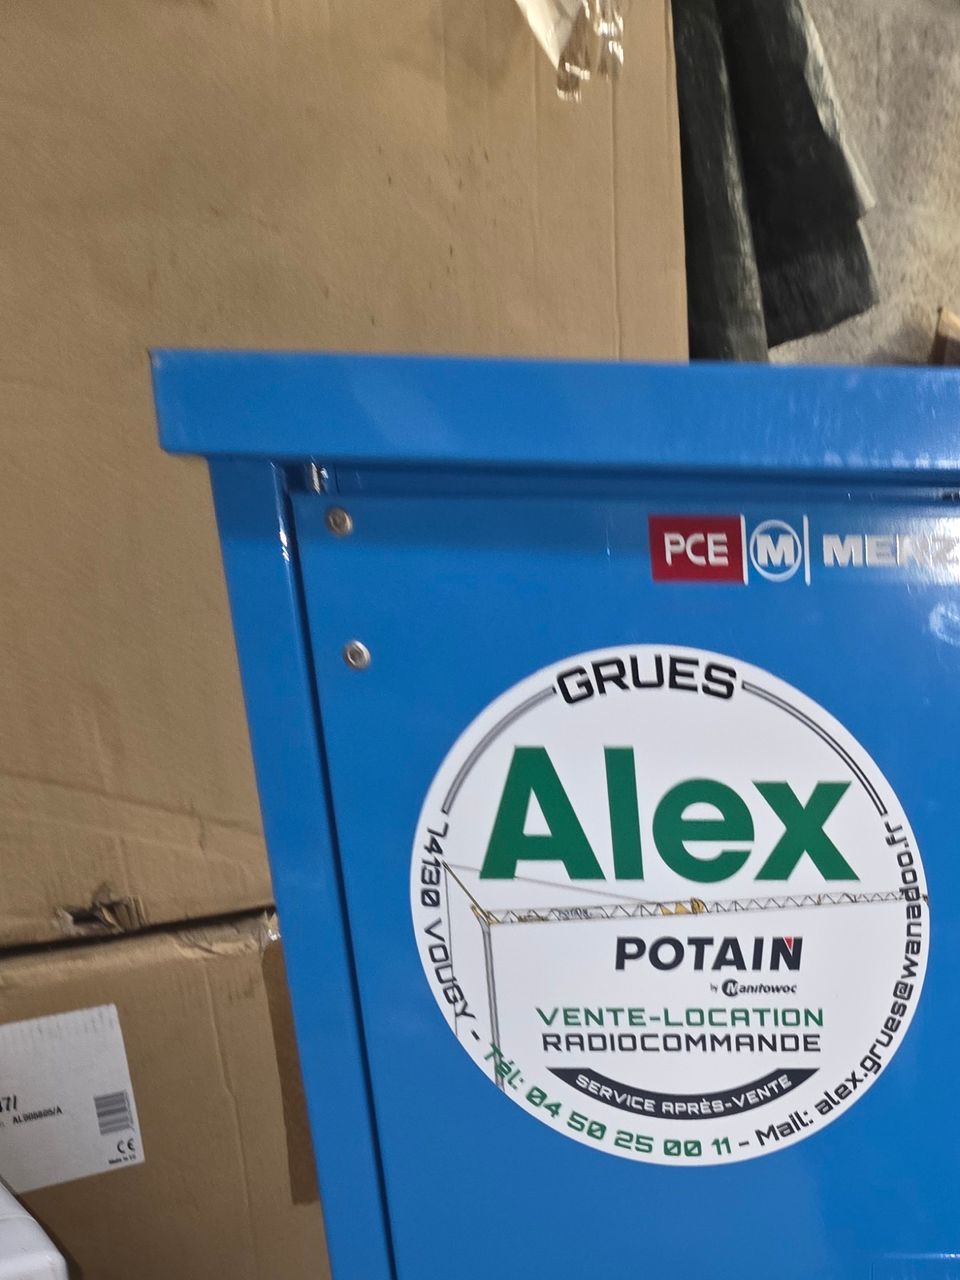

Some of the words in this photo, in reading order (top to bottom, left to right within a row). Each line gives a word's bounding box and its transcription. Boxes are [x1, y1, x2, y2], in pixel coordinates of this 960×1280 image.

[663, 532, 729, 567] PCE
[556, 655, 737, 704] GRUES
[479, 745, 860, 882] Alex
[420, 822, 449, 907] 74130
[424, 918, 476, 1019] VOUGY
[615, 936, 803, 971] POTAIN
[535, 1007, 824, 1027] VENTE-LOCATION
[541, 1033, 821, 1052] RADIOCOMMANDE
[525, 1086, 562, 1118] 04
[575, 1074, 656, 1113] SERVICE
[567, 1110, 607, 1141] 50
[613, 1130, 654, 1154] 25
[755, 1109, 814, 1147] Mail:
[663, 1138, 702, 1157] 00
[711, 1136, 732, 1156] 11
